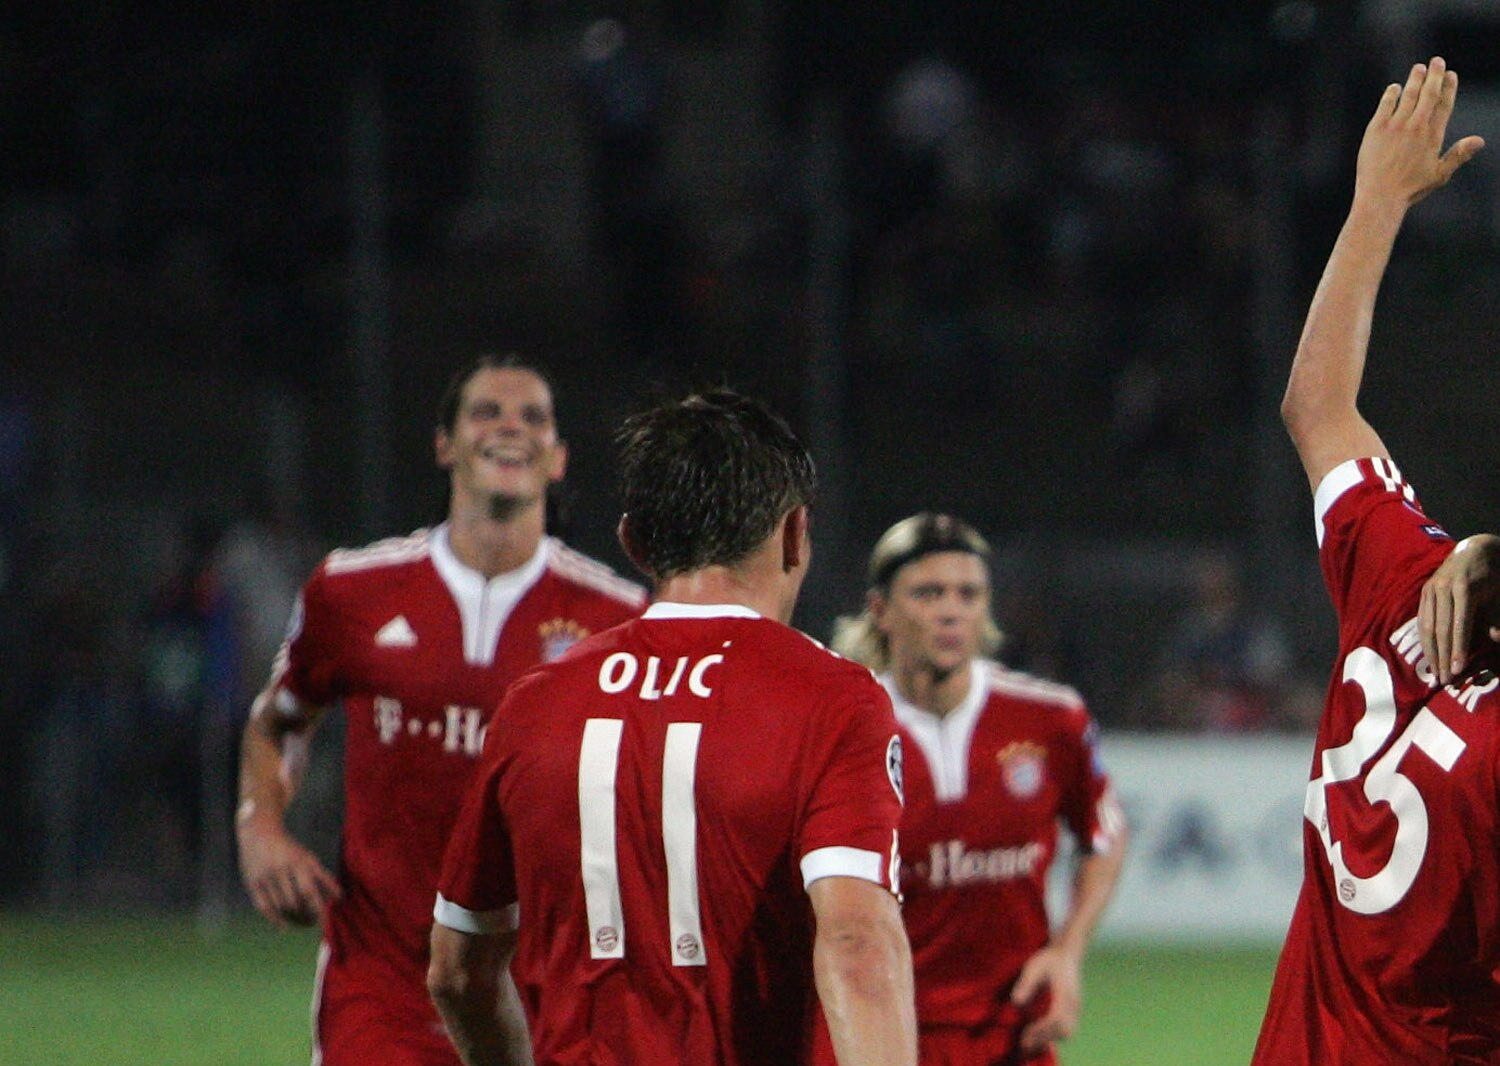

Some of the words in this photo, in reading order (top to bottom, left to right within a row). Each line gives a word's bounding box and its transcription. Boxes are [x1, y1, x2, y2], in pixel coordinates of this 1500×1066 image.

[598, 640, 733, 700] OLIĆ
[1303, 646, 1467, 915] 25
[578, 718, 707, 967] 11
